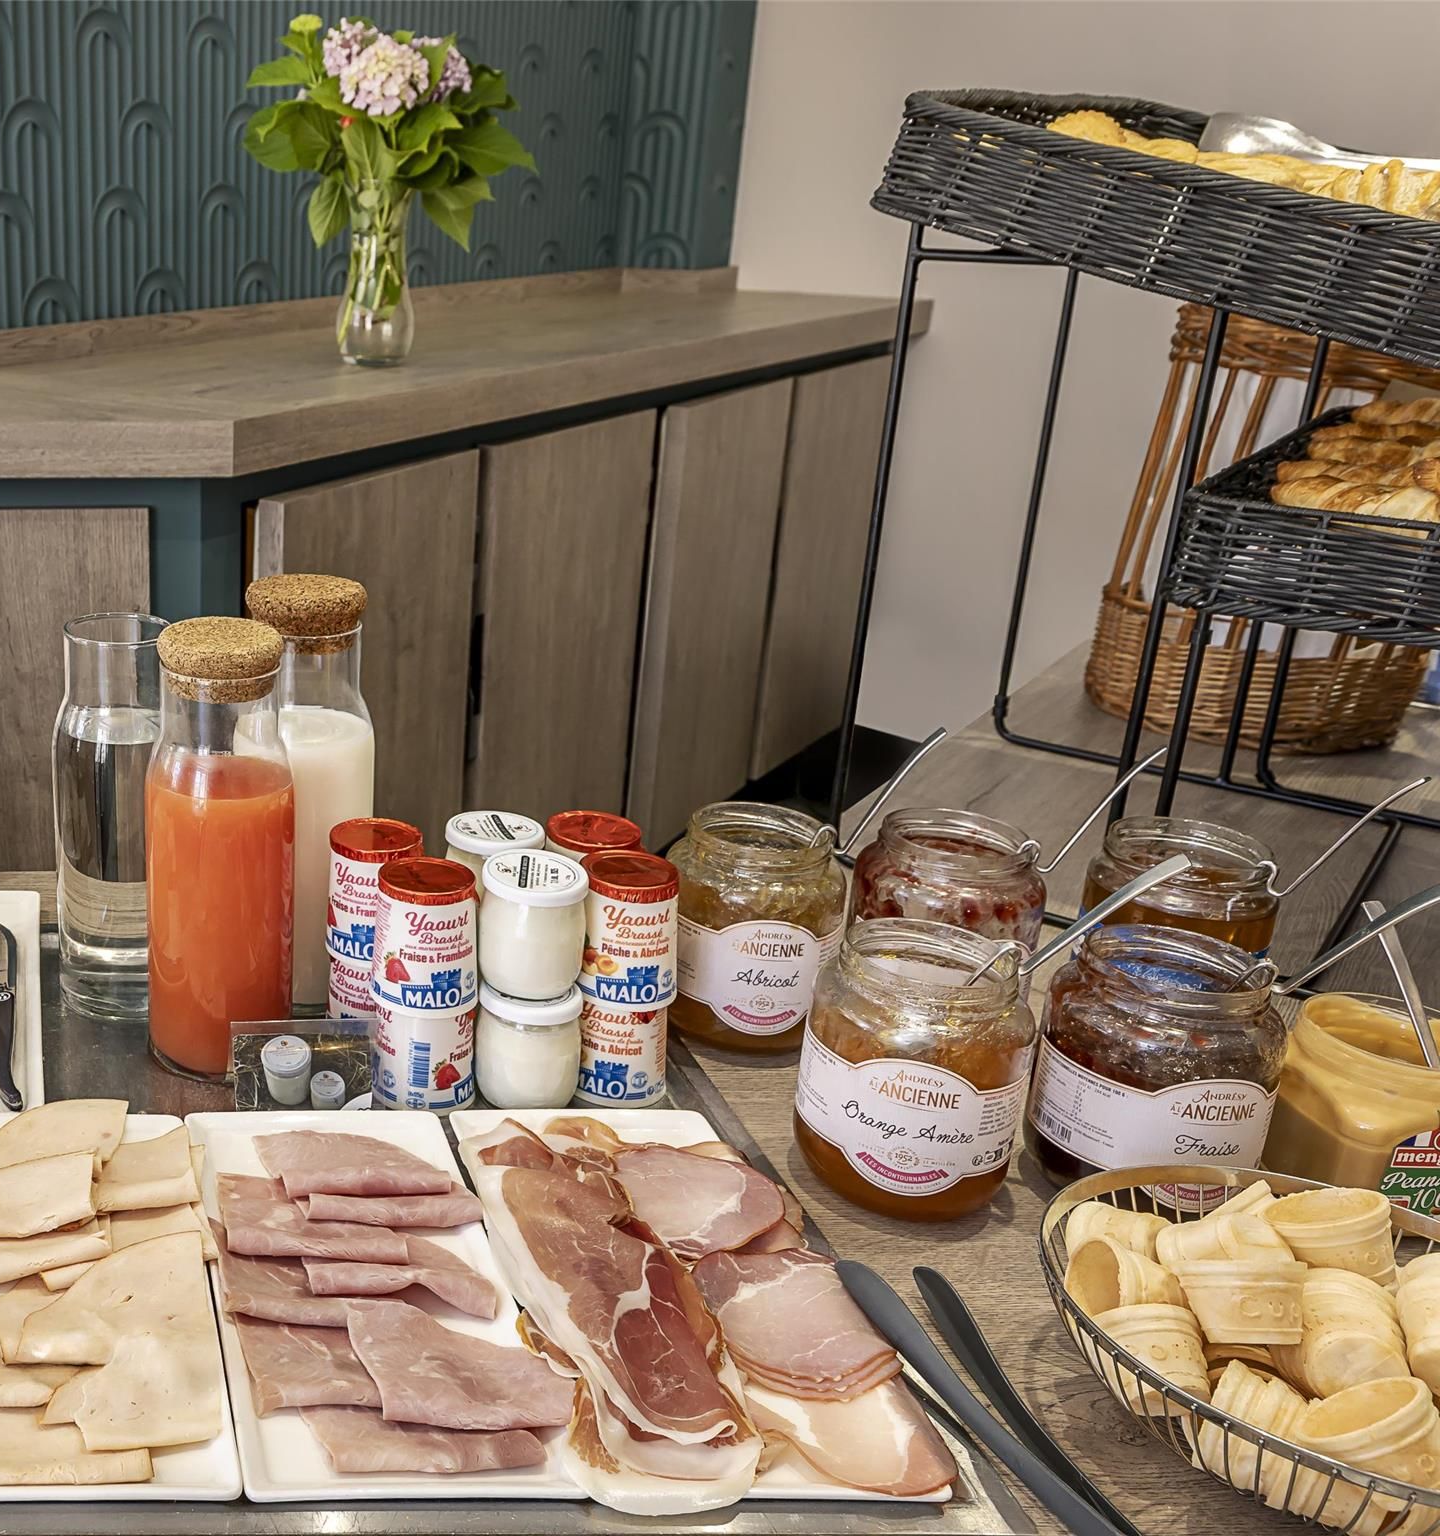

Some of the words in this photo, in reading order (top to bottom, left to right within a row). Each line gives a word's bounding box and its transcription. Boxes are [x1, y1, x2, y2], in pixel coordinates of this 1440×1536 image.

[342, 884, 378, 900] Brass
[356, 906, 377, 918] Fram
[603, 905, 670, 929] Yaourt
[405, 911, 469, 936] Yaourt
[418, 930, 463, 945] Brassé
[616, 927, 663, 940] Brassé
[399, 948, 427, 963] Fraise
[429, 955, 435, 963] &
[601, 943, 631, 958] Pêche
[632, 950, 638, 958] &
[640, 944, 669, 958] Abricot
[336, 974, 370, 994] Brass
[731, 969, 800, 988] Abricot
[405, 988, 461, 1008] MALO
[600, 983, 657, 1003] MALO
[344, 996, 376, 1012] Framboi
[587, 1020, 635, 1038] Brassé
[608, 1044, 642, 1056] Abricot
[888, 1070, 946, 1088] ANDRÉSY
[1099, 1082, 1112, 1092] POUR
[458, 1081, 473, 1103] MA
[1192, 1089, 1247, 1104] ANDRÉSY
[841, 1100, 907, 1140] Orange
[912, 1125, 975, 1144] Amère
[1174, 1134, 1241, 1157] Fraise
[894, 1152, 913, 1163] 1952
[1396, 1152, 1440, 1166] men
[866, 1157, 876, 1168] LES
[877, 1164, 938, 1182] INCONTOURNABLES
